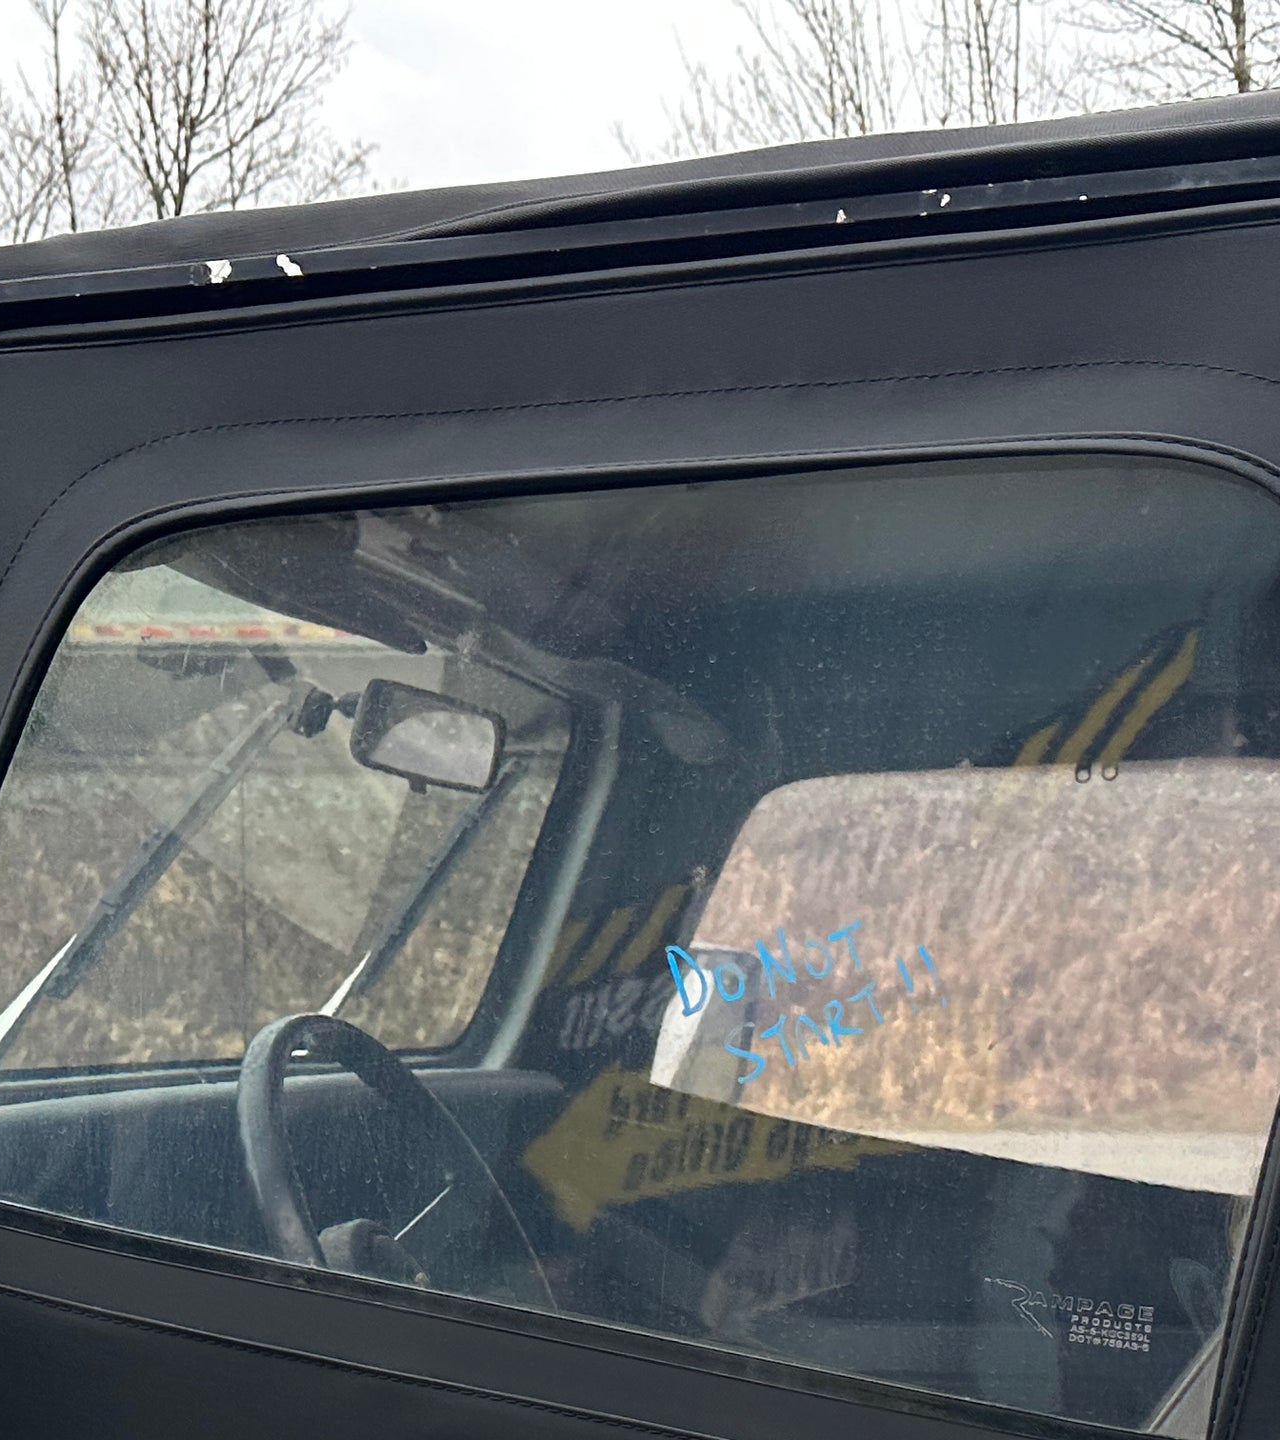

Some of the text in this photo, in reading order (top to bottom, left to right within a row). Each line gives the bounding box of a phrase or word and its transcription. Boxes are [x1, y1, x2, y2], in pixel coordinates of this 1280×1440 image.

[665, 945, 746, 1017] DO
[755, 918, 862, 998] NOT
[984, 1277, 1154, 1340] RAMPAGE
[1071, 1315, 1152, 1334] PRODUCTS
